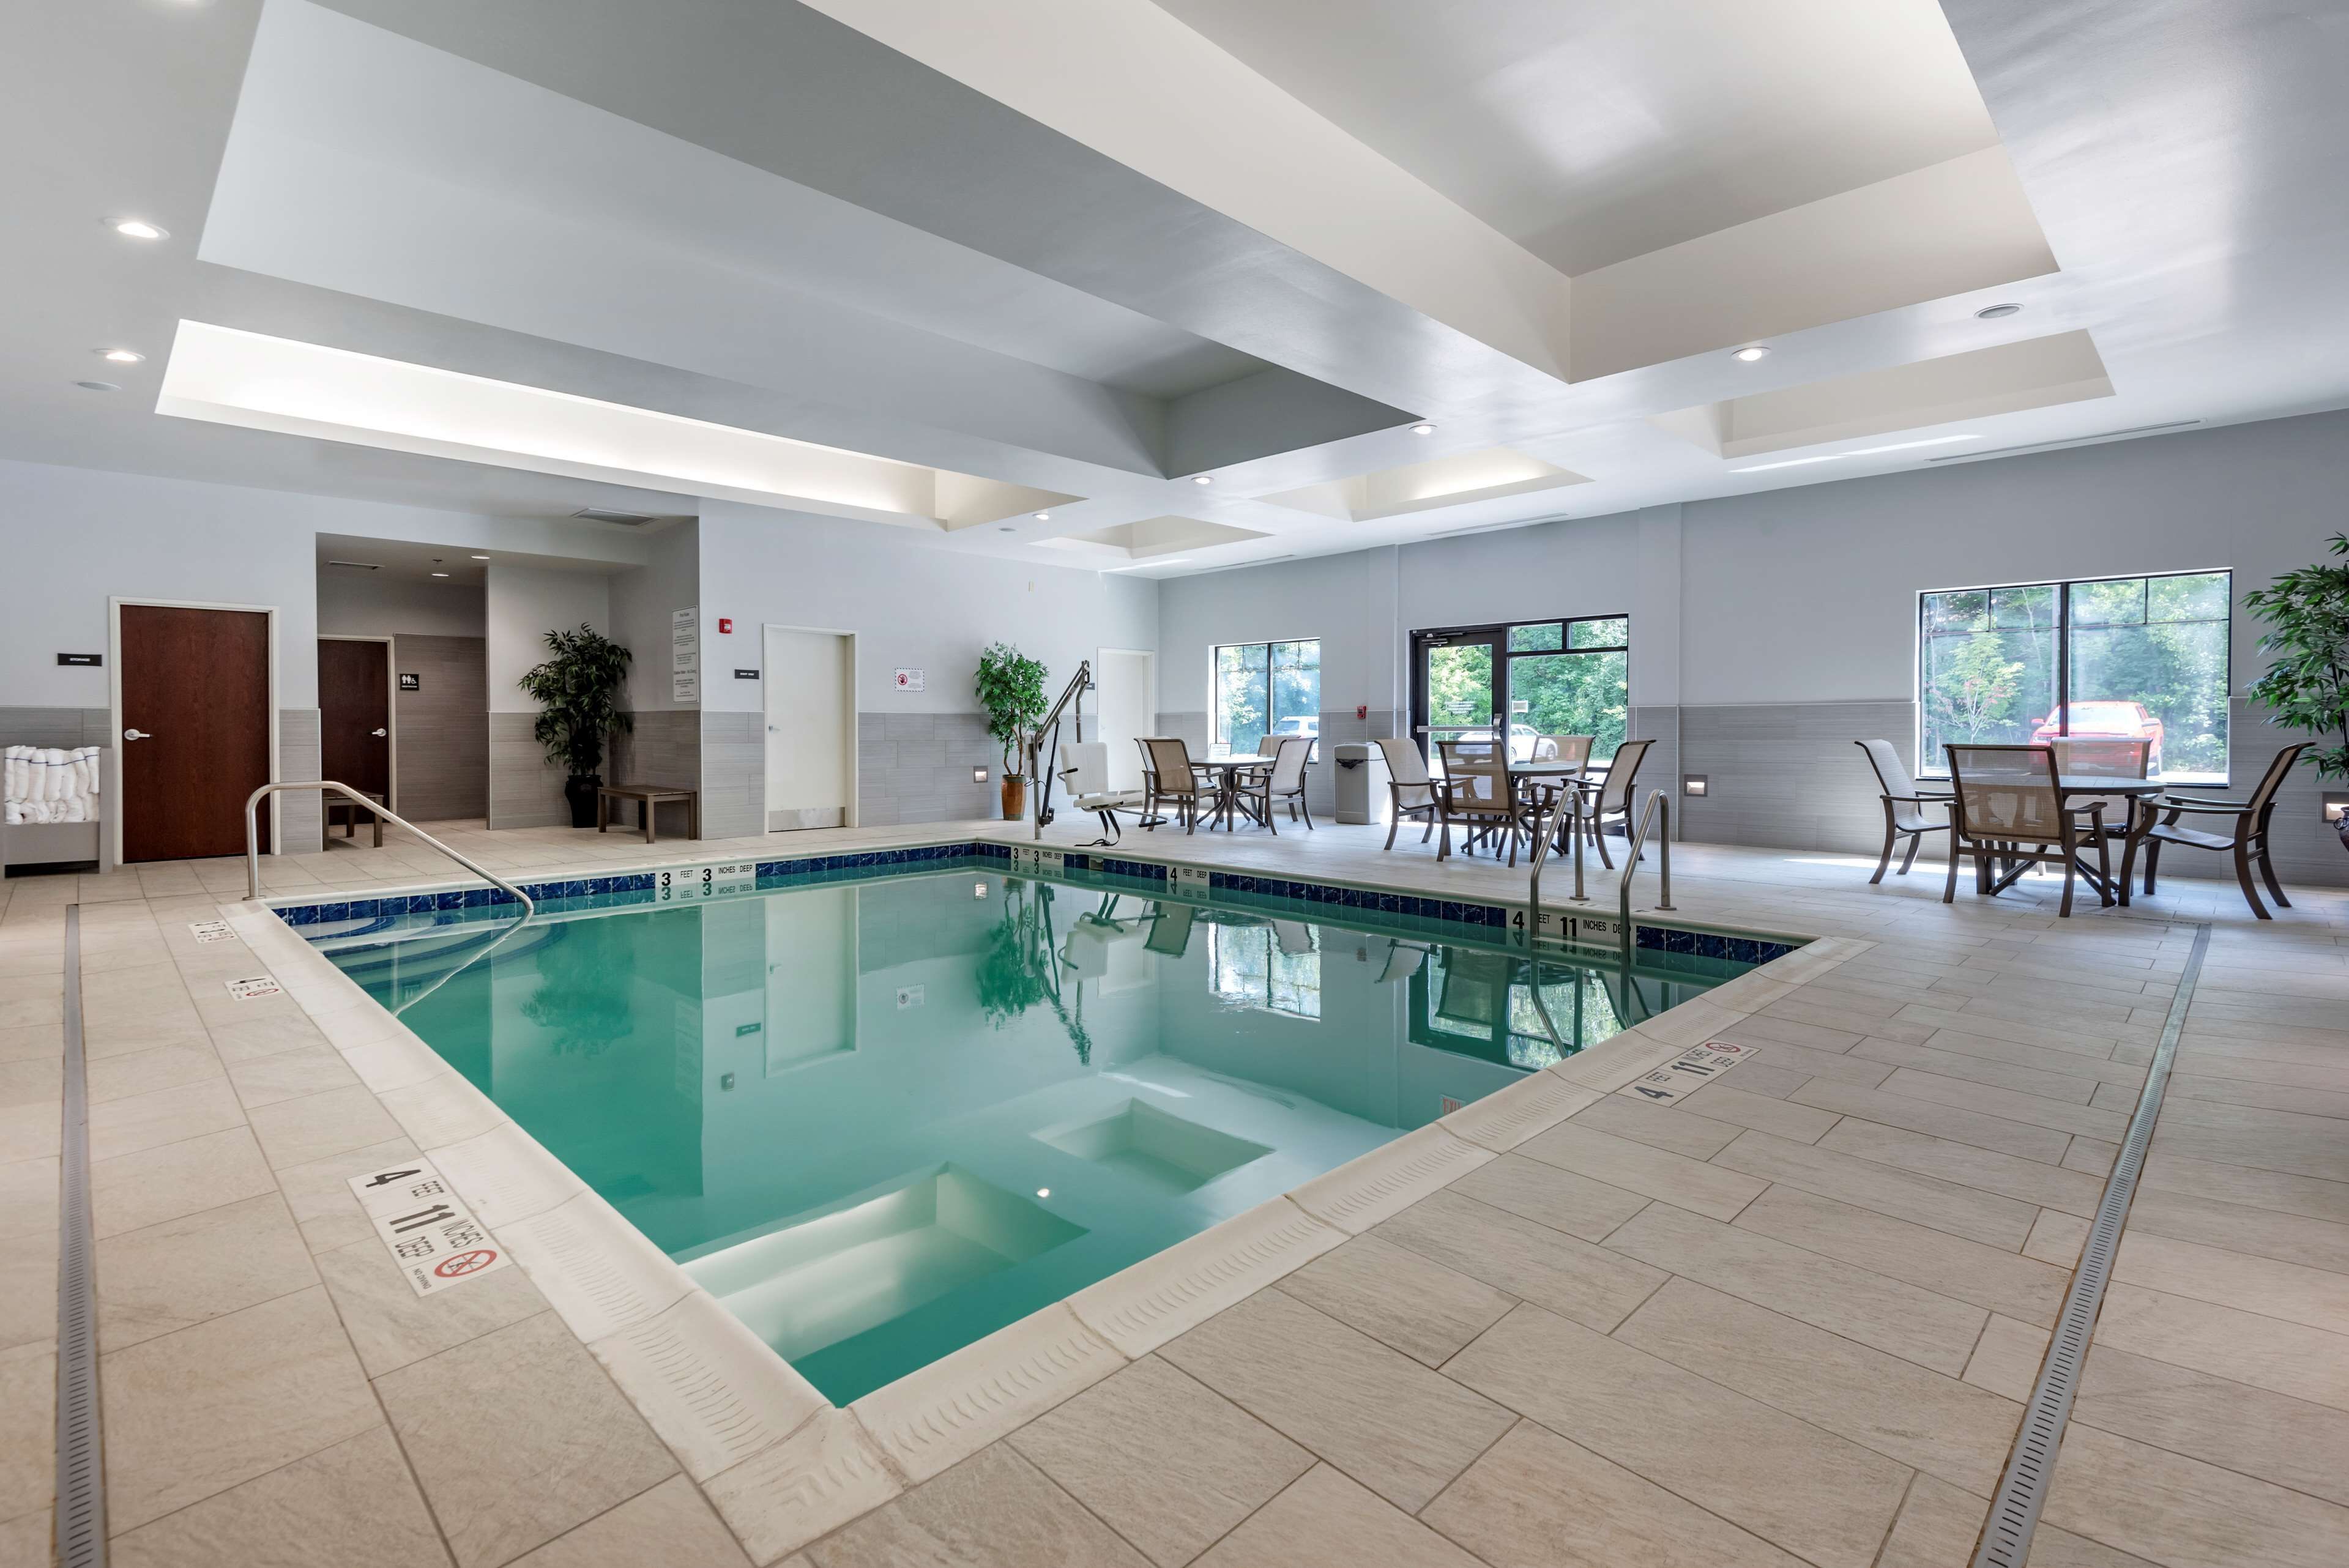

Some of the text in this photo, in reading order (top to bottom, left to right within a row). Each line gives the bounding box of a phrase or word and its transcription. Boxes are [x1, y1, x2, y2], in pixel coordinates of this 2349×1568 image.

[1014, 848, 1019, 860] 3
[1034, 850, 1040, 863] 3
[661, 872, 671, 886] 3
[680, 870, 693, 879] FEET
[702, 868, 712, 882] 3
[718, 866, 735, 874] INCHES
[1171, 868, 1177, 882] 4
[1513, 911, 1524, 929] 4
[1538, 913, 1550, 924] EET
[1560, 917, 1577, 937] 11
[1583, 920, 1606, 931] INCHES
[1634, 1086, 1674, 1099] 4
[1670, 1061, 1715, 1076] 11
[365, 1169, 484, 1248] 4 FEET 11 INCHES
[395, 1236, 435, 1259] DEEP
